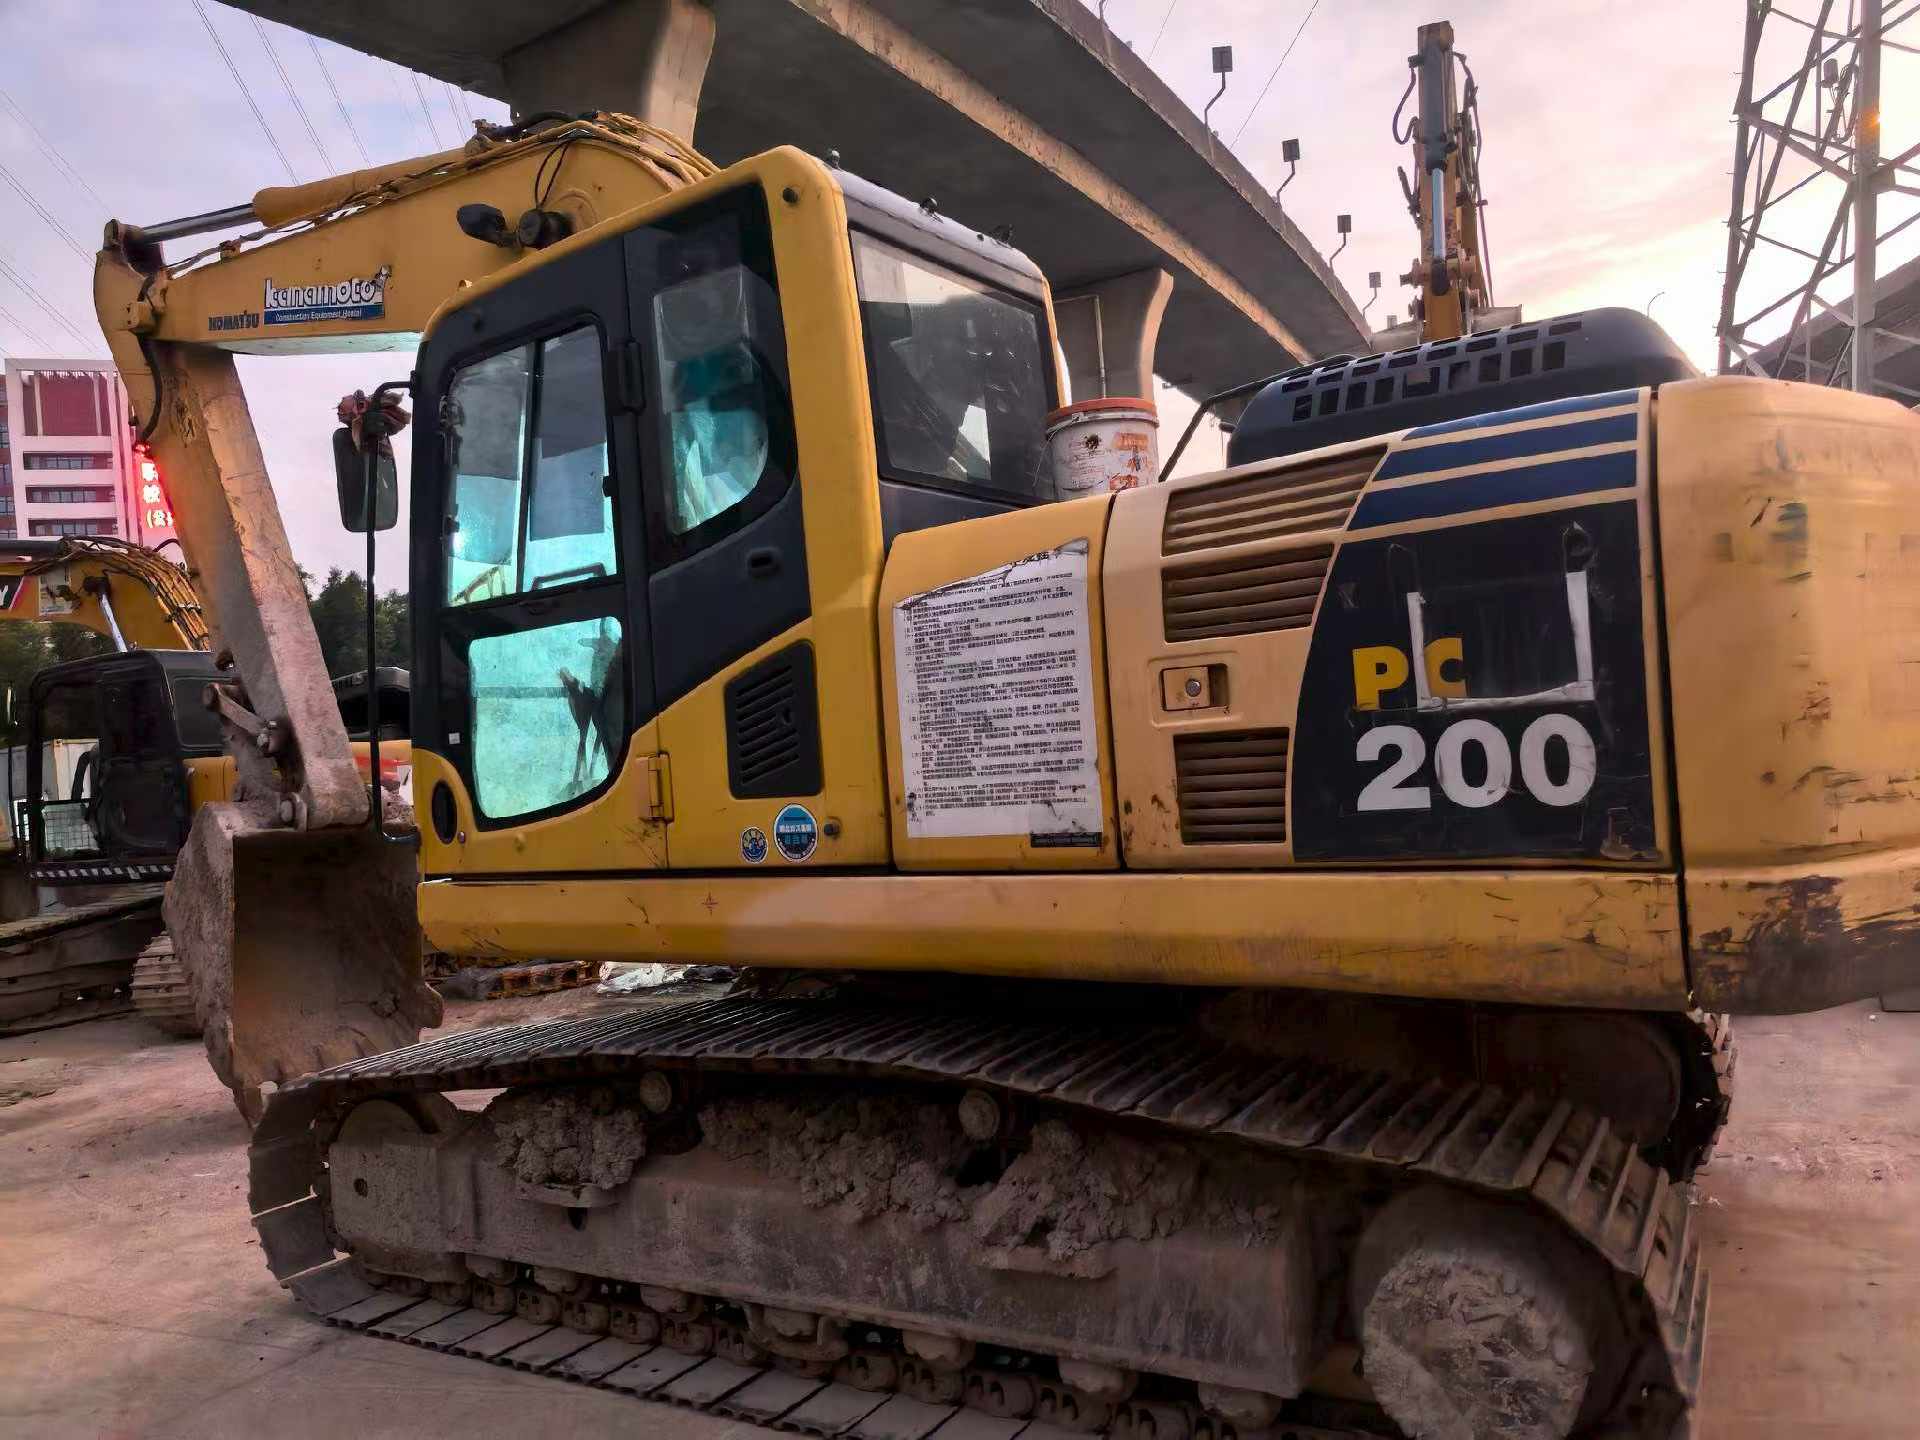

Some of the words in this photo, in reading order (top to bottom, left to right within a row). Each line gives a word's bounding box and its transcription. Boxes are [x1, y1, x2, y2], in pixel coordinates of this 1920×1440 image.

[265, 278, 375, 307] kanamoto
[208, 313, 259, 330] KOMATSU
[311, 310, 342, 320] Equipment
[1352, 637, 1469, 712] PC
[1356, 713, 1597, 812] 200
